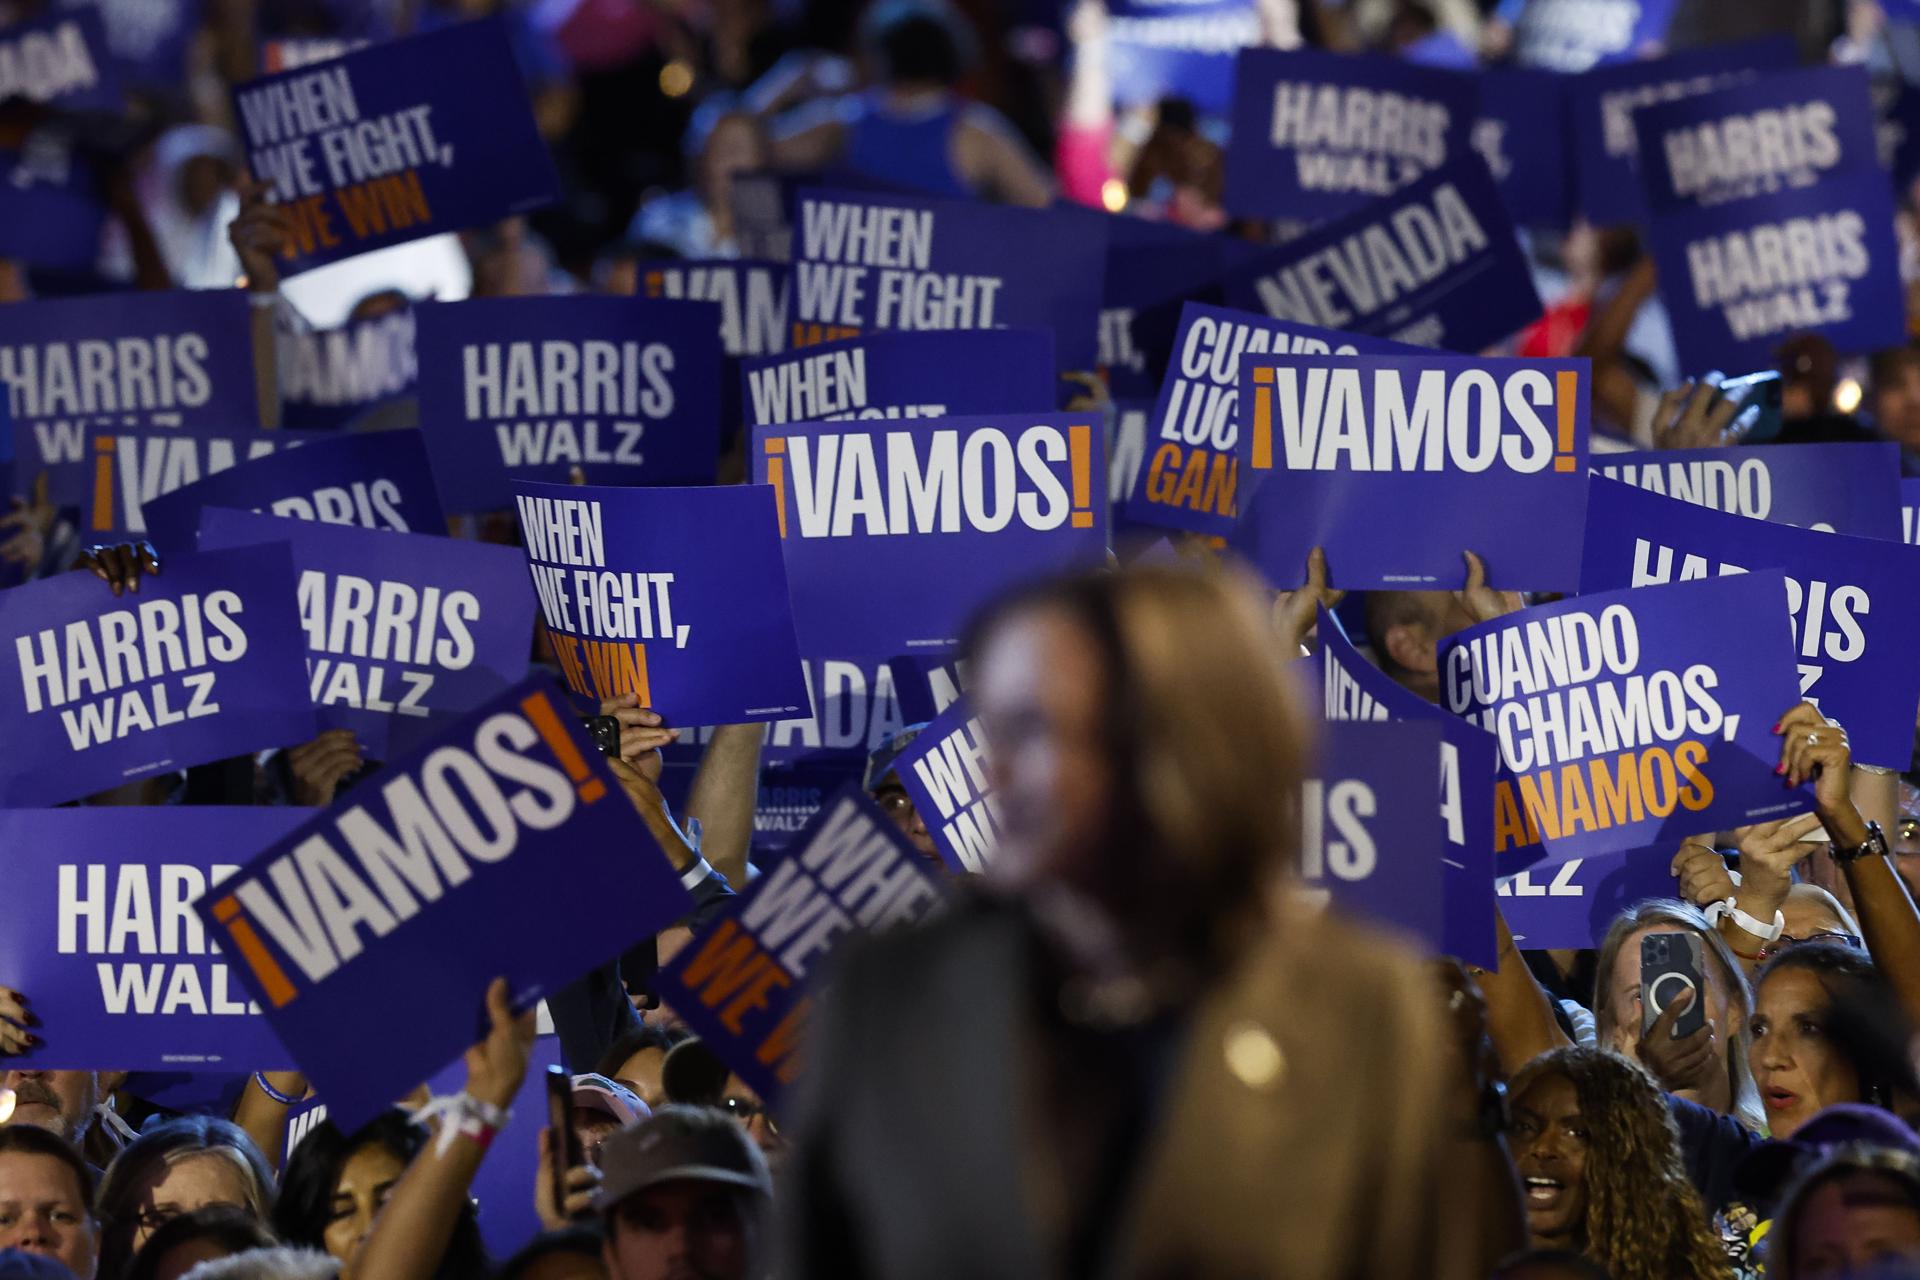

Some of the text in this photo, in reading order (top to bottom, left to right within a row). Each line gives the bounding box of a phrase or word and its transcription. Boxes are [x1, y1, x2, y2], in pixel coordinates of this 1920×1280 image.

[238, 65, 360, 148] WHEN
[1269, 80, 1450, 171] HARRIS
[1664, 101, 1841, 197] HARRIS
[252, 104, 454, 203] WE FIGHT,
[335, 169, 432, 240] WIN
[803, 200, 933, 271] WHEN
[797, 259, 867, 327] WE
[875, 269, 1008, 331] FIGHT
[1255, 182, 1489, 330] NEVADA
[1686, 209, 1870, 309] HARRIS
[1722, 278, 1852, 341] WALZ
[0, 332, 211, 417] HARRIS
[463, 340, 675, 420] HARRIS
[749, 348, 867, 425] WHEN
[496, 420, 643, 467] WALZ
[1252, 366, 1577, 474] ¡VAMOS!
[516, 495, 605, 567] WHEN
[298, 570, 480, 670] ARRIS
[530, 563, 691, 649] WE FIGHT,
[16, 590, 248, 713] HARRIS
[546, 630, 652, 709] WE WIN
[1447, 604, 1639, 713] CUANDO
[60, 671, 220, 751] WALZ
[1468, 664, 1740, 774] CHAMOS,
[1495, 741, 1714, 853] ANAMOS
[211, 691, 607, 1009] ¡VAMOS!
[740, 857, 853, 978] WE
[97, 963, 263, 1014] WAL
[681, 919, 793, 1036] WE
